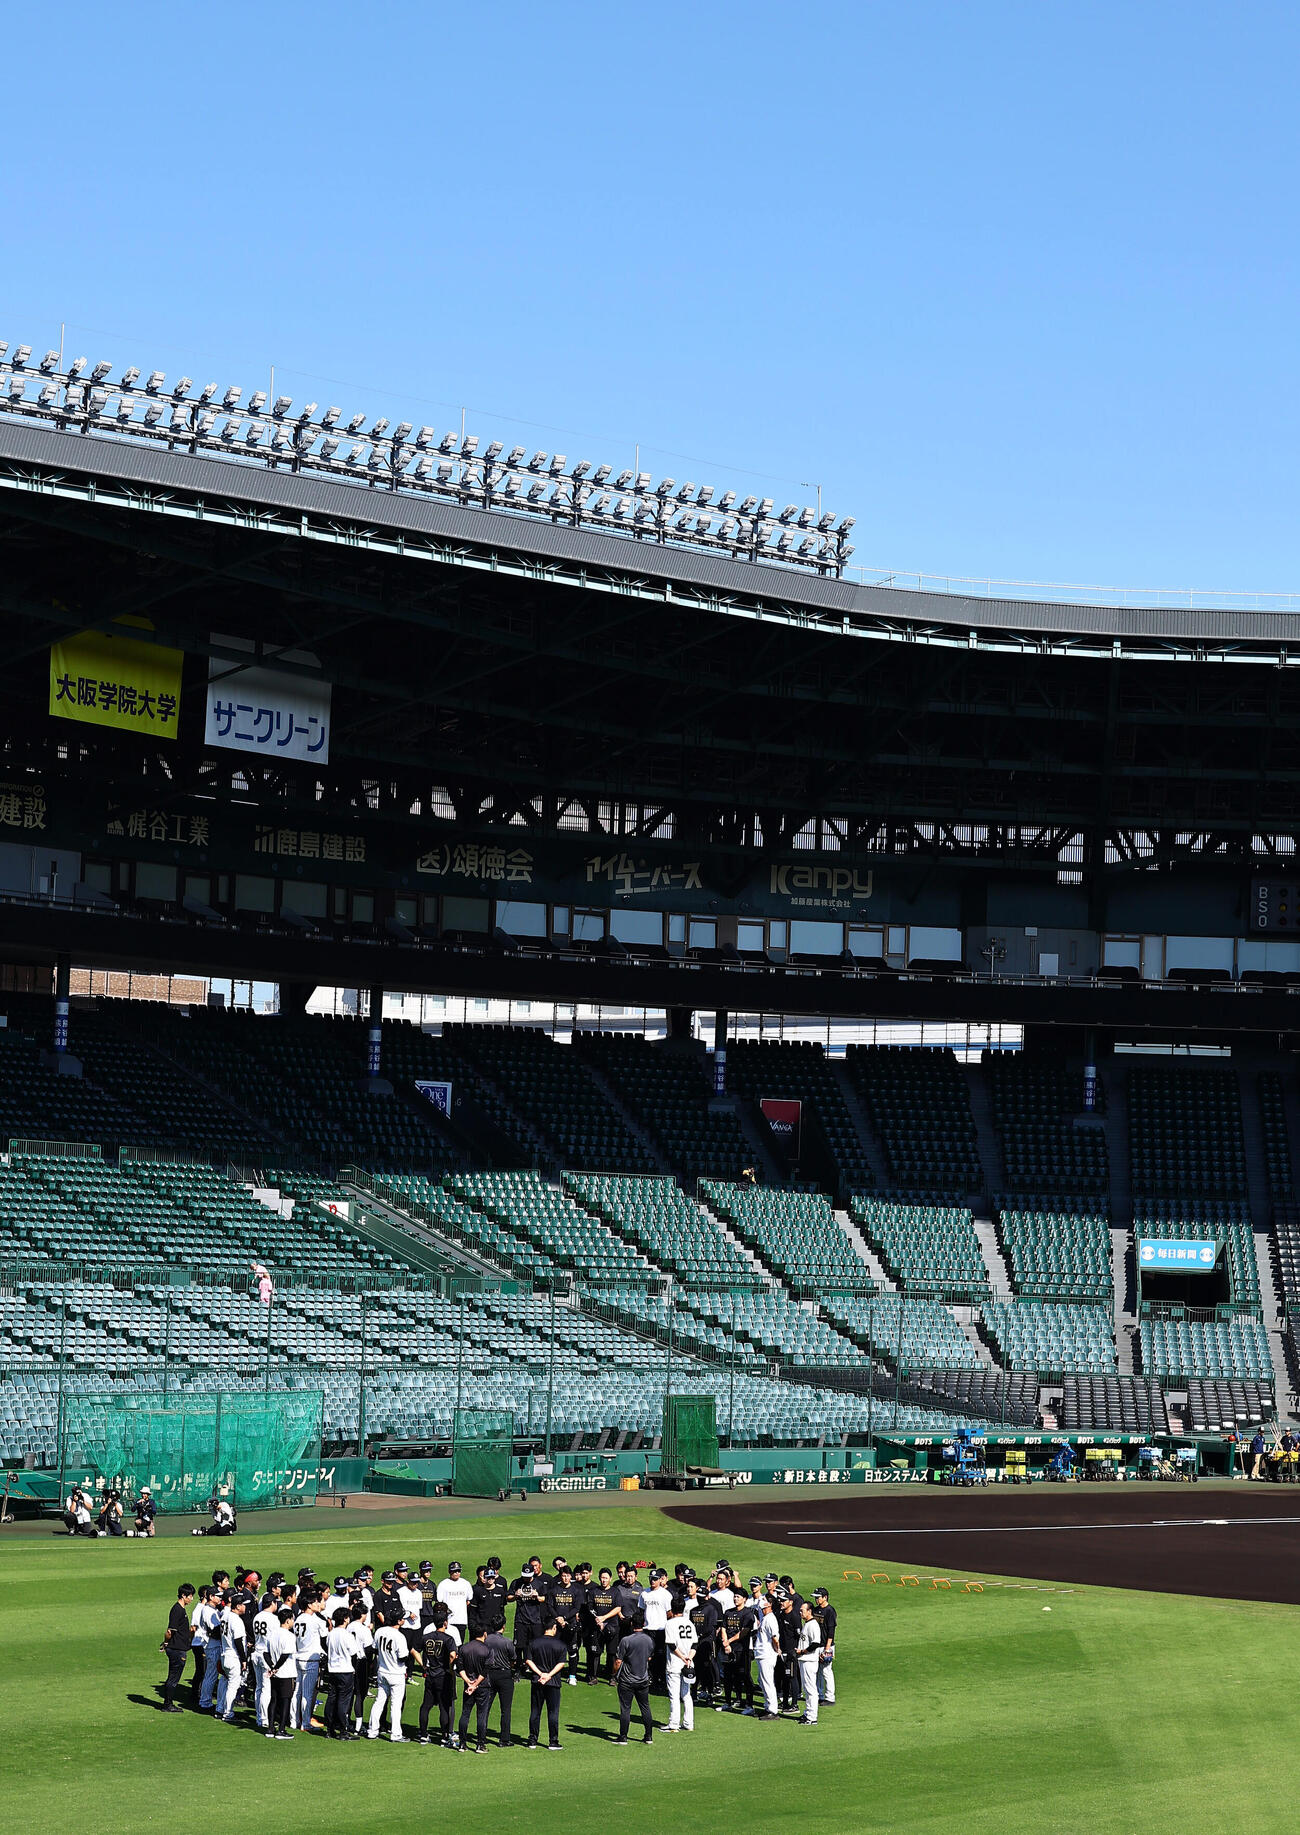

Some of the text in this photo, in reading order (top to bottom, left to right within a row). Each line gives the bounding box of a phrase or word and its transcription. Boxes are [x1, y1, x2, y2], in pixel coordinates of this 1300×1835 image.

[56, 673, 176, 722] 大阪学院大学
[214, 700, 325, 752] サニクリーン
[128, 808, 209, 847] 梶谷工業
[277, 829, 366, 863] 鹿島建設
[770, 864, 874, 899] Kanpy
[1259, 887, 1268, 898] B
[1258, 901, 1268, 912] S
[1158, 1248, 1197, 1260] 毎日新聞
[865, 1469, 929, 1483] 日立システムズ
[254, 1620, 267, 1636] 88
[678, 1625, 692, 1639] 22
[379, 1635, 393, 1654] 114
[425, 1639, 443, 1658] 27
